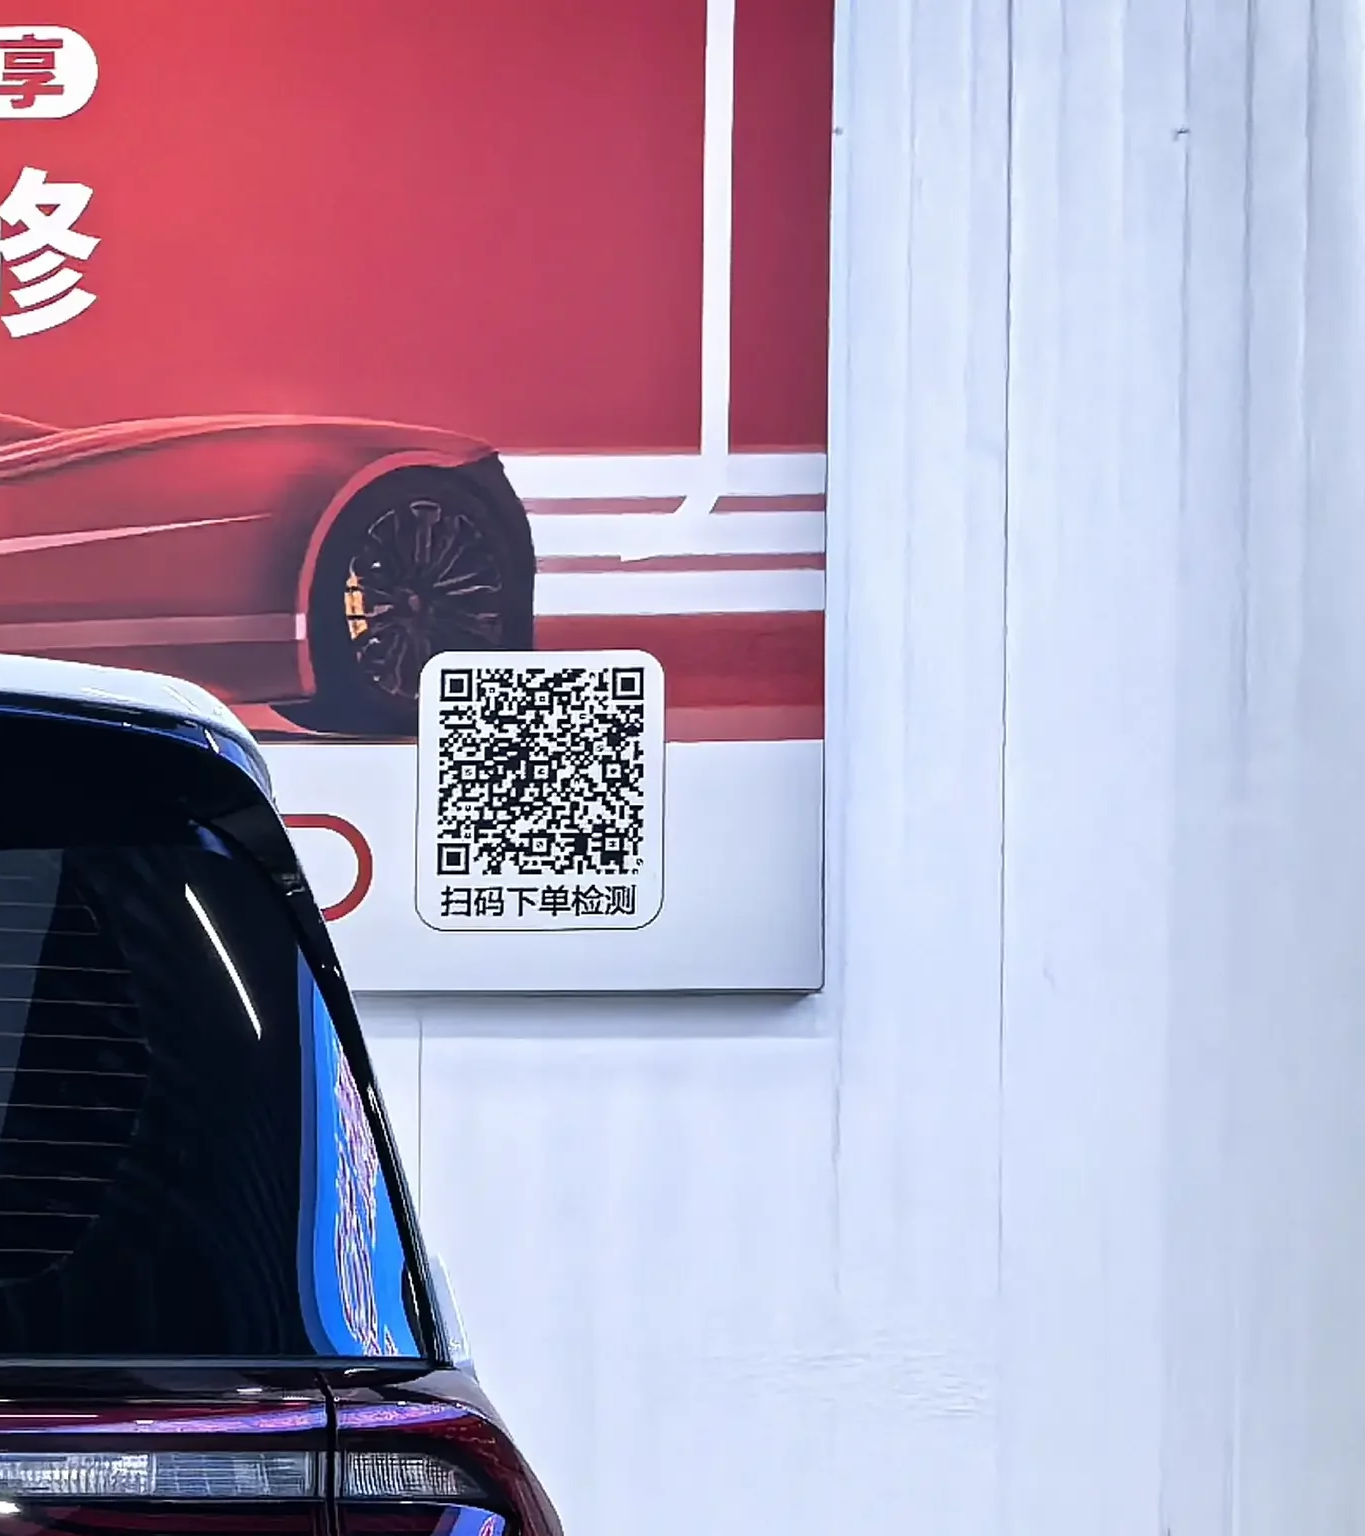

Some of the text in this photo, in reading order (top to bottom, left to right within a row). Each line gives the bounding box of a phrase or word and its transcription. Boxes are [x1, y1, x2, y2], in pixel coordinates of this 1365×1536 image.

[440, 884, 638, 918] 扫码下单检测
